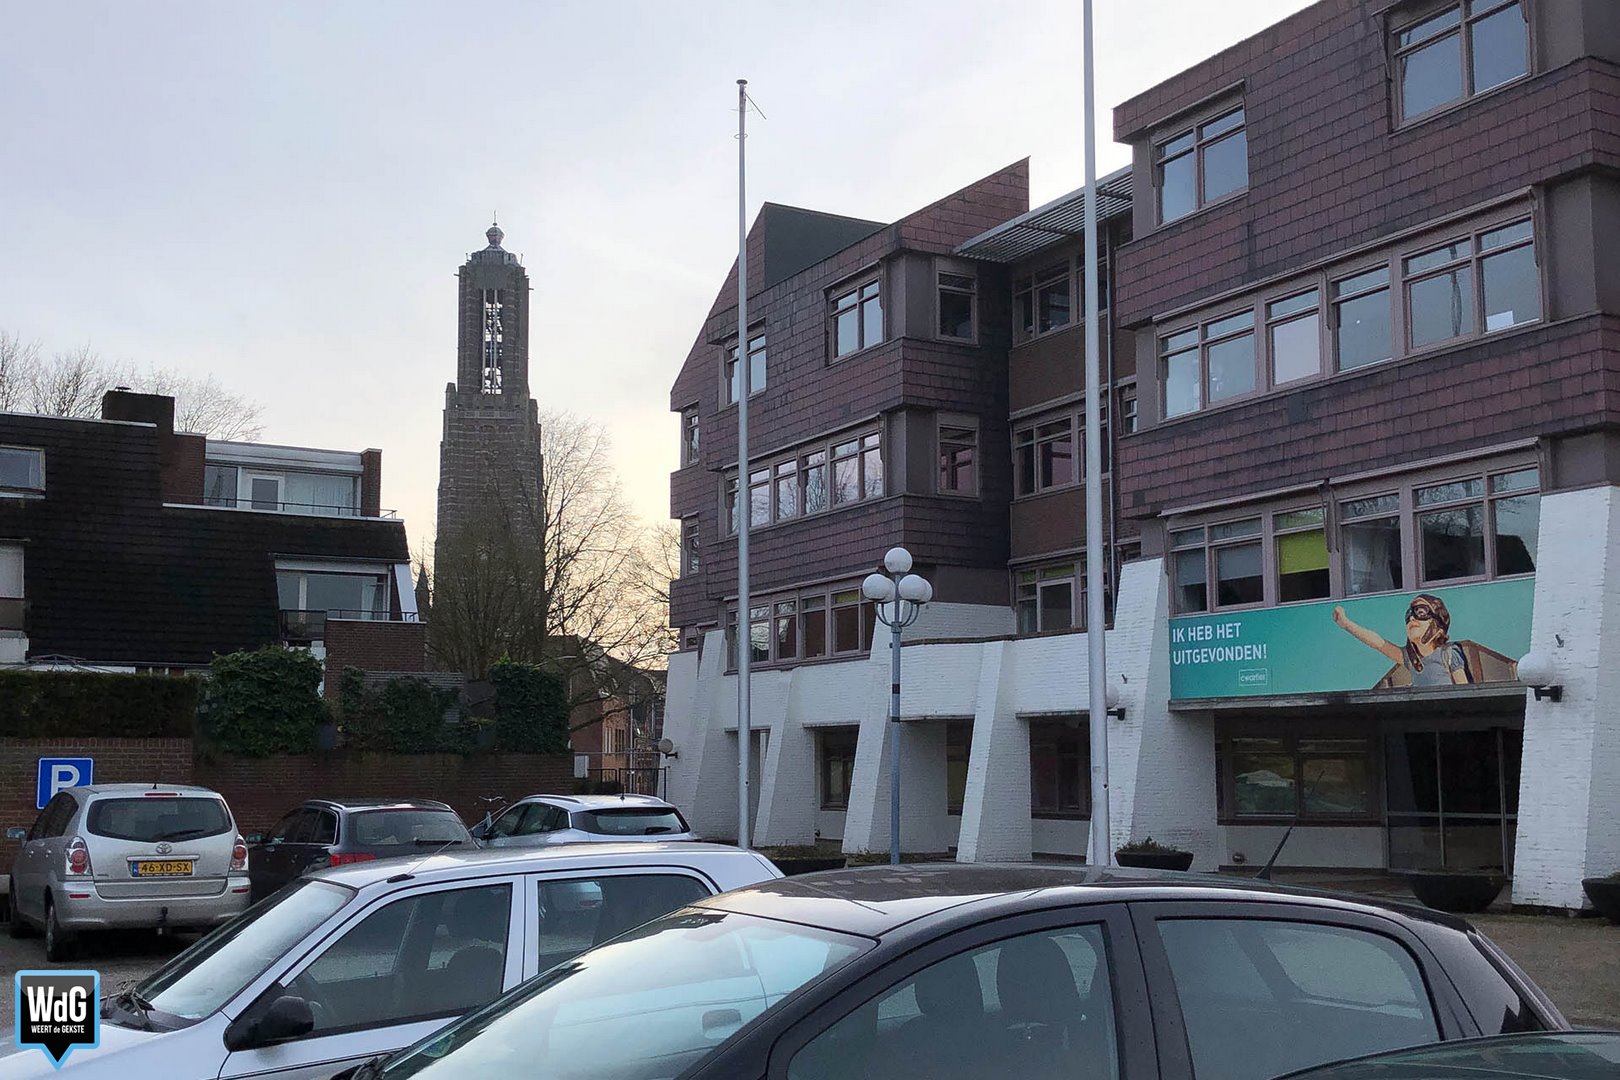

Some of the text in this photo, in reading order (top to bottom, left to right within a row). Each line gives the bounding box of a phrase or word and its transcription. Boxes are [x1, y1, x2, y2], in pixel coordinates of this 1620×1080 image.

[1172, 622, 1241, 643] IK HEB HET
[1173, 644, 1267, 665] UITGEVONDEN!
[51, 765, 80, 797] P
[141, 862, 190, 873] 46-XD-SX
